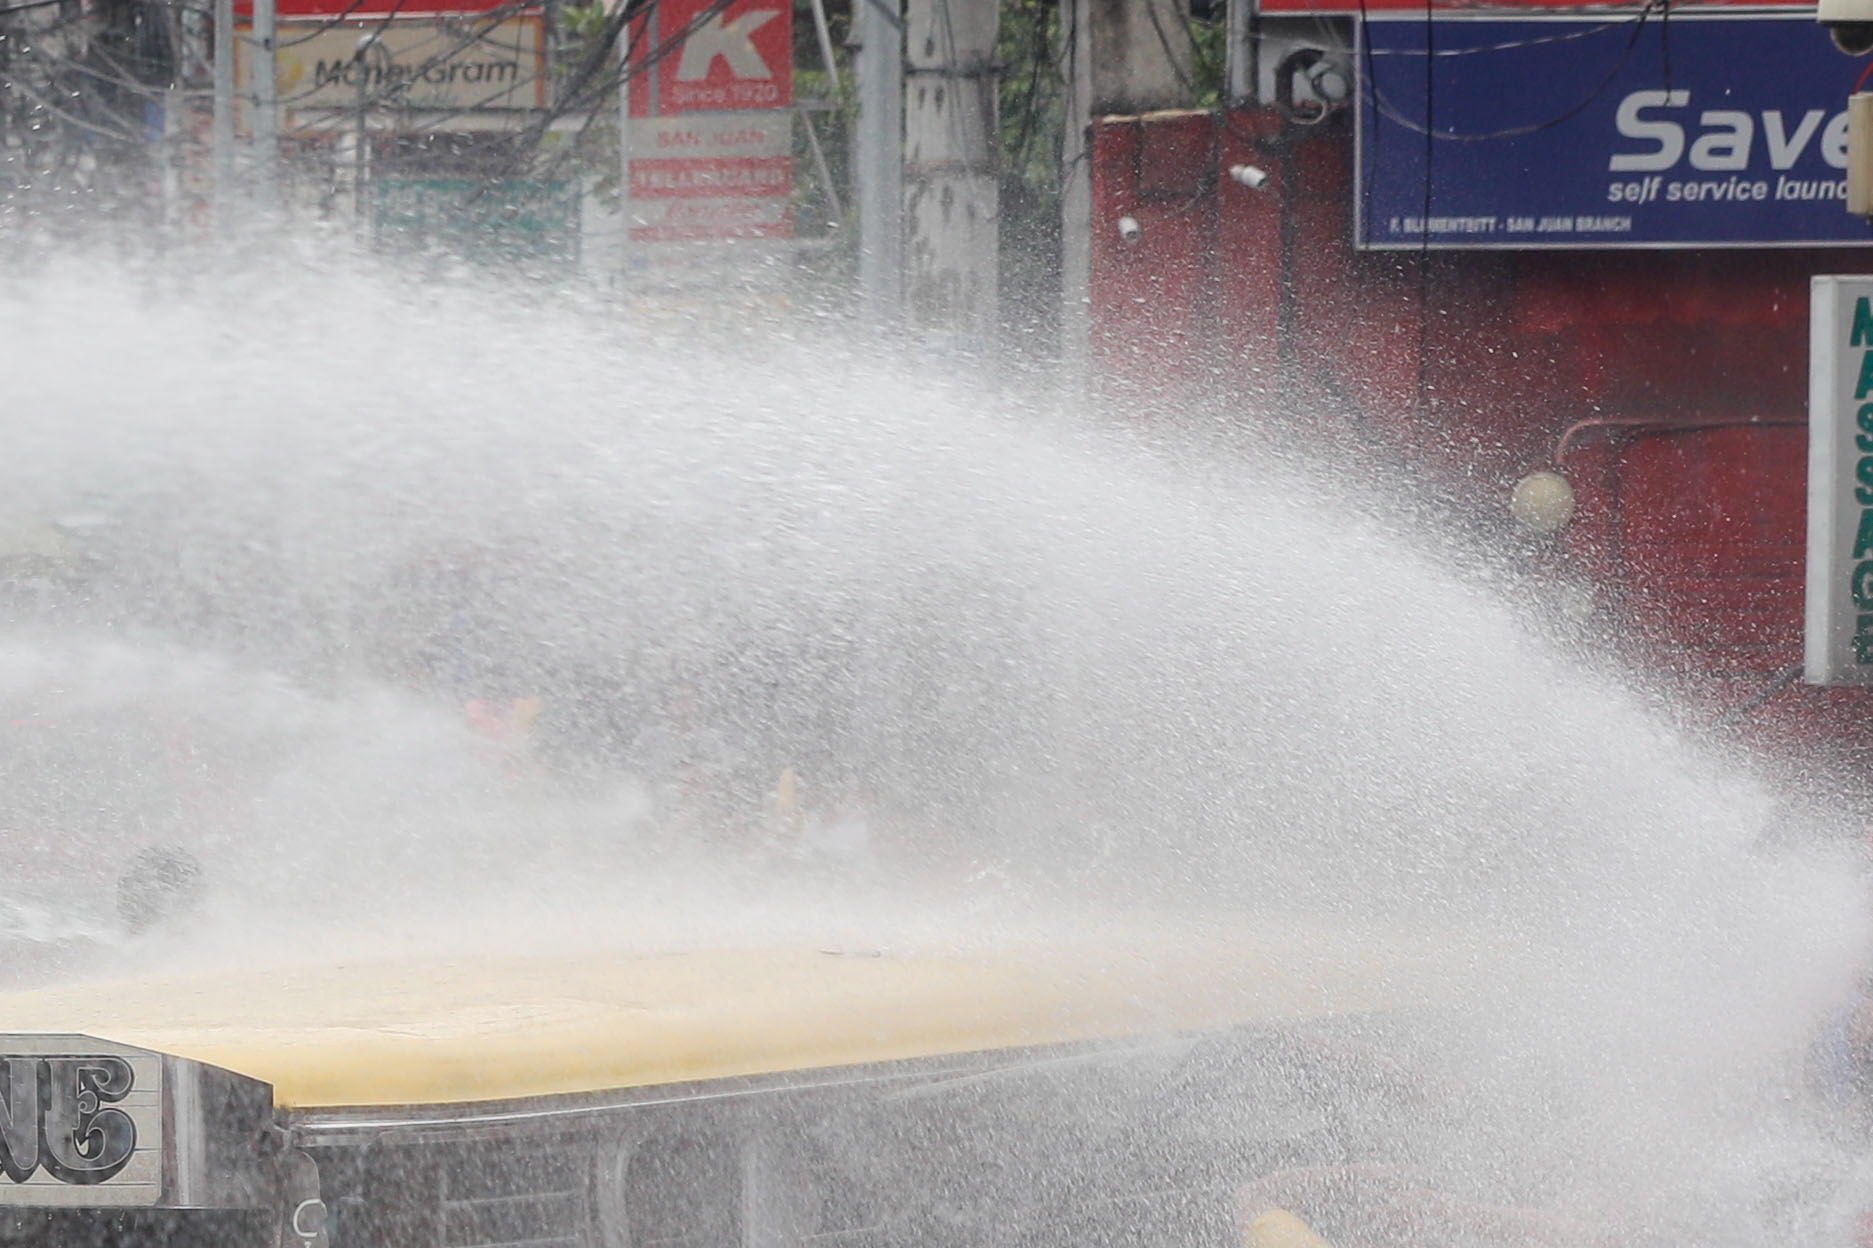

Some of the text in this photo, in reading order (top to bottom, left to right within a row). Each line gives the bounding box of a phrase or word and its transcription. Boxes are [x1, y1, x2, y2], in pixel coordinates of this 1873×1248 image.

[677, 9, 782, 81] K
[315, 57, 518, 91] MoneyGram
[1608, 176, 1663, 205] self
[1665, 176, 1768, 201] service
